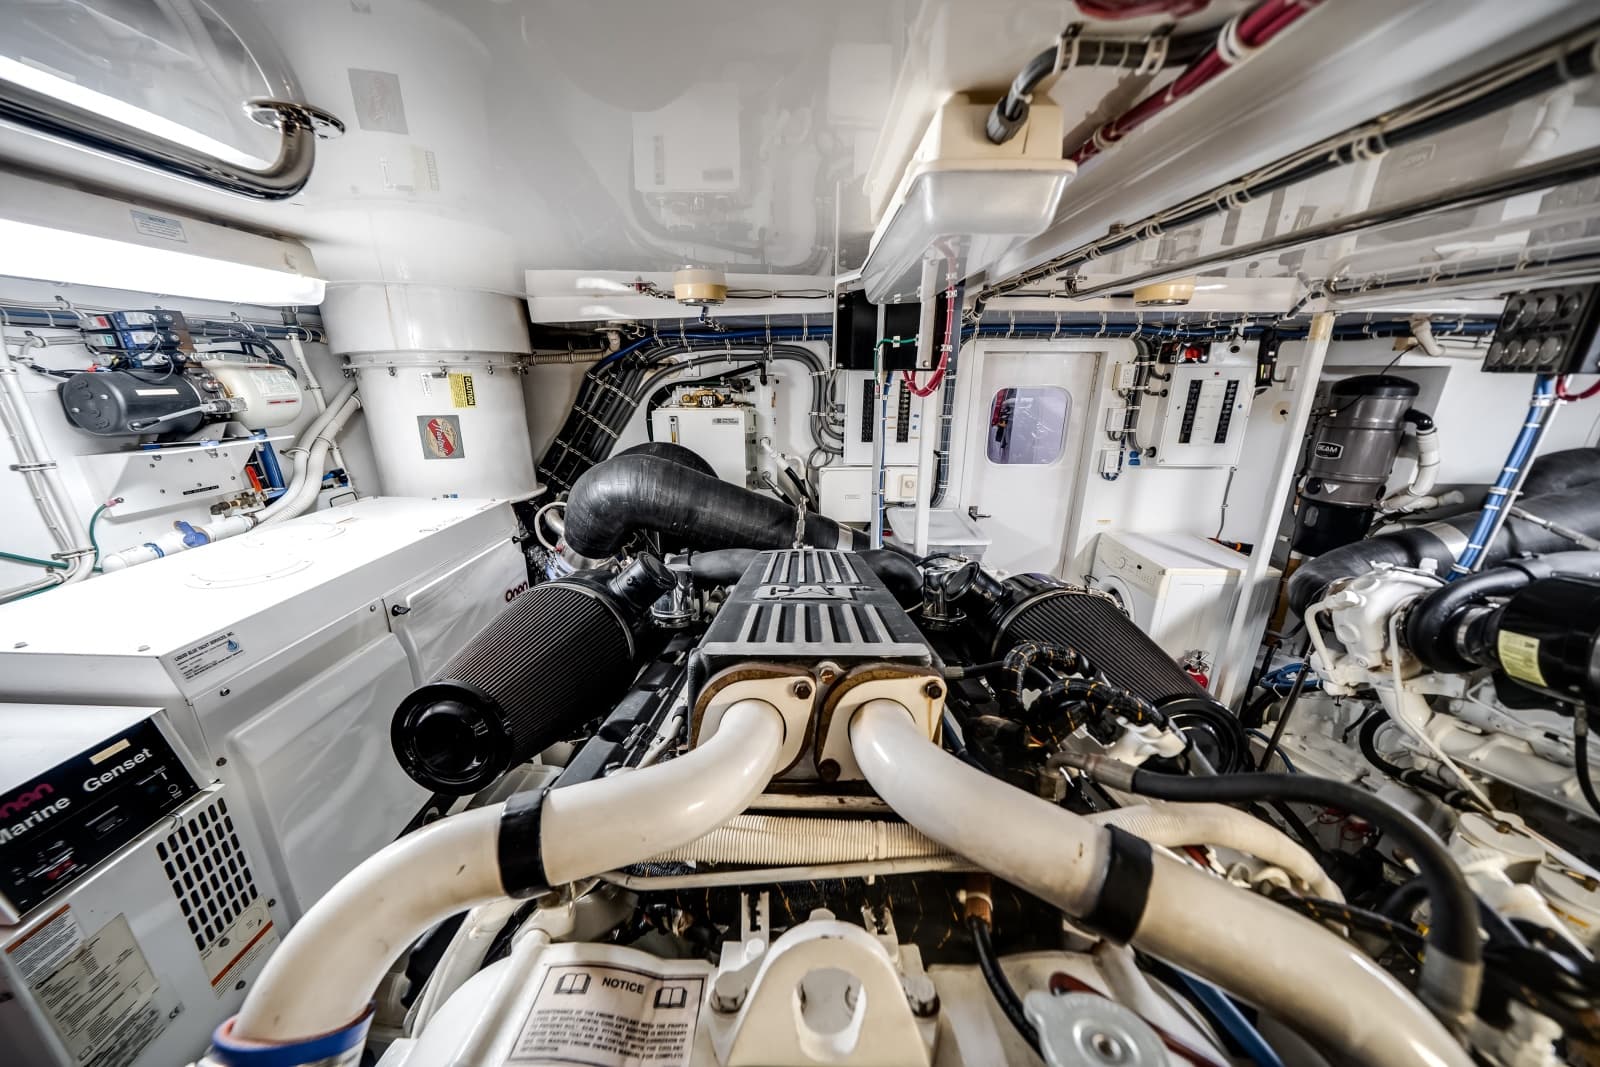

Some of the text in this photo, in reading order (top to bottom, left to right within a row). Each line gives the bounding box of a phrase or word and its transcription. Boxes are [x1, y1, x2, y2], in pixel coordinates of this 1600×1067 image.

[465, 377, 476, 406] CAUTION
[754, 585, 858, 600] CAT
[83, 748, 152, 792] Genset
[0, 784, 54, 818] nan
[0, 798, 71, 844] Marine
[602, 976, 646, 995] NOTICE
